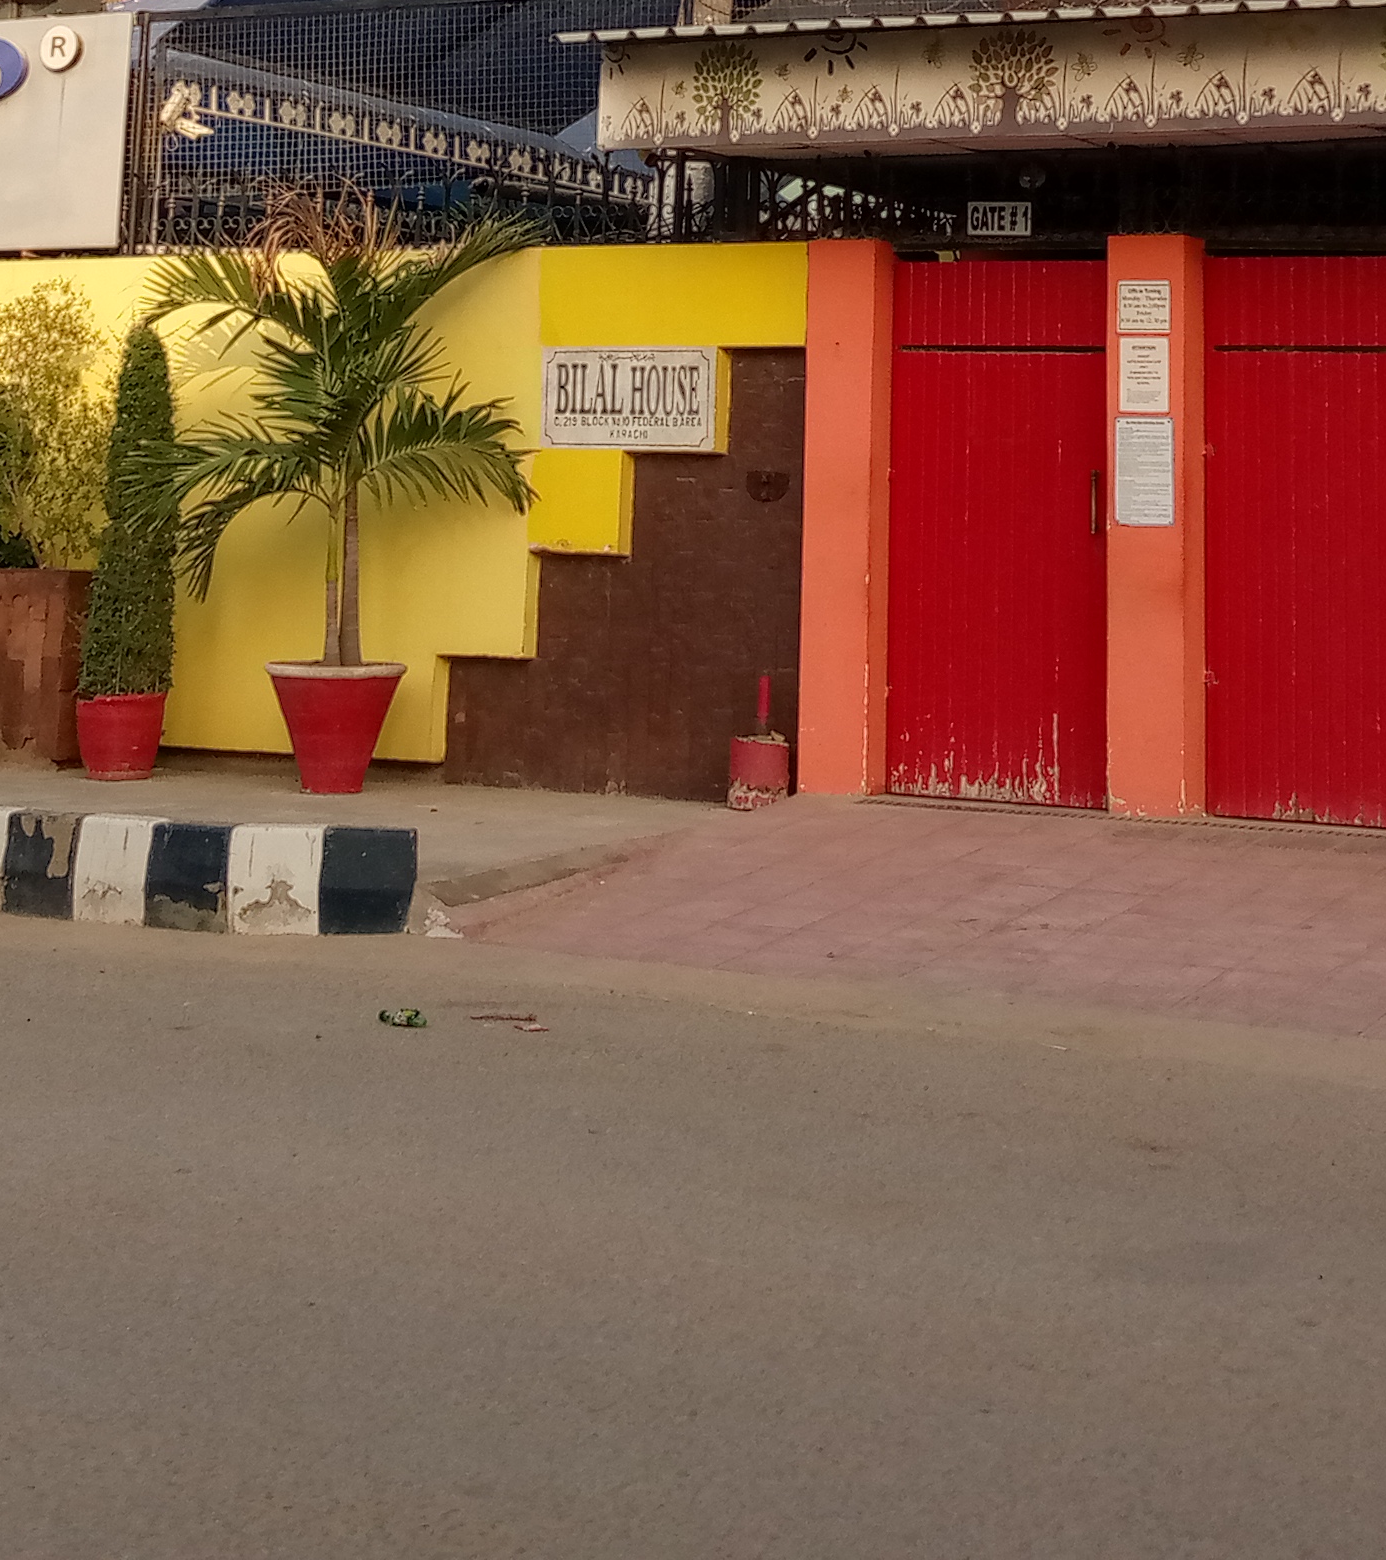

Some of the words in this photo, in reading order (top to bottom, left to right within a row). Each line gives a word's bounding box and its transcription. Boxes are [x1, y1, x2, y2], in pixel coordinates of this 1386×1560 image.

[971, 205, 1006, 232] GATE
[554, 363, 624, 415] BILAL
[629, 364, 700, 417] HOUSE
[580, 416, 610, 428] BLOCK
[632, 416, 671, 428] FEDERAL
[680, 416, 703, 428] AREA
